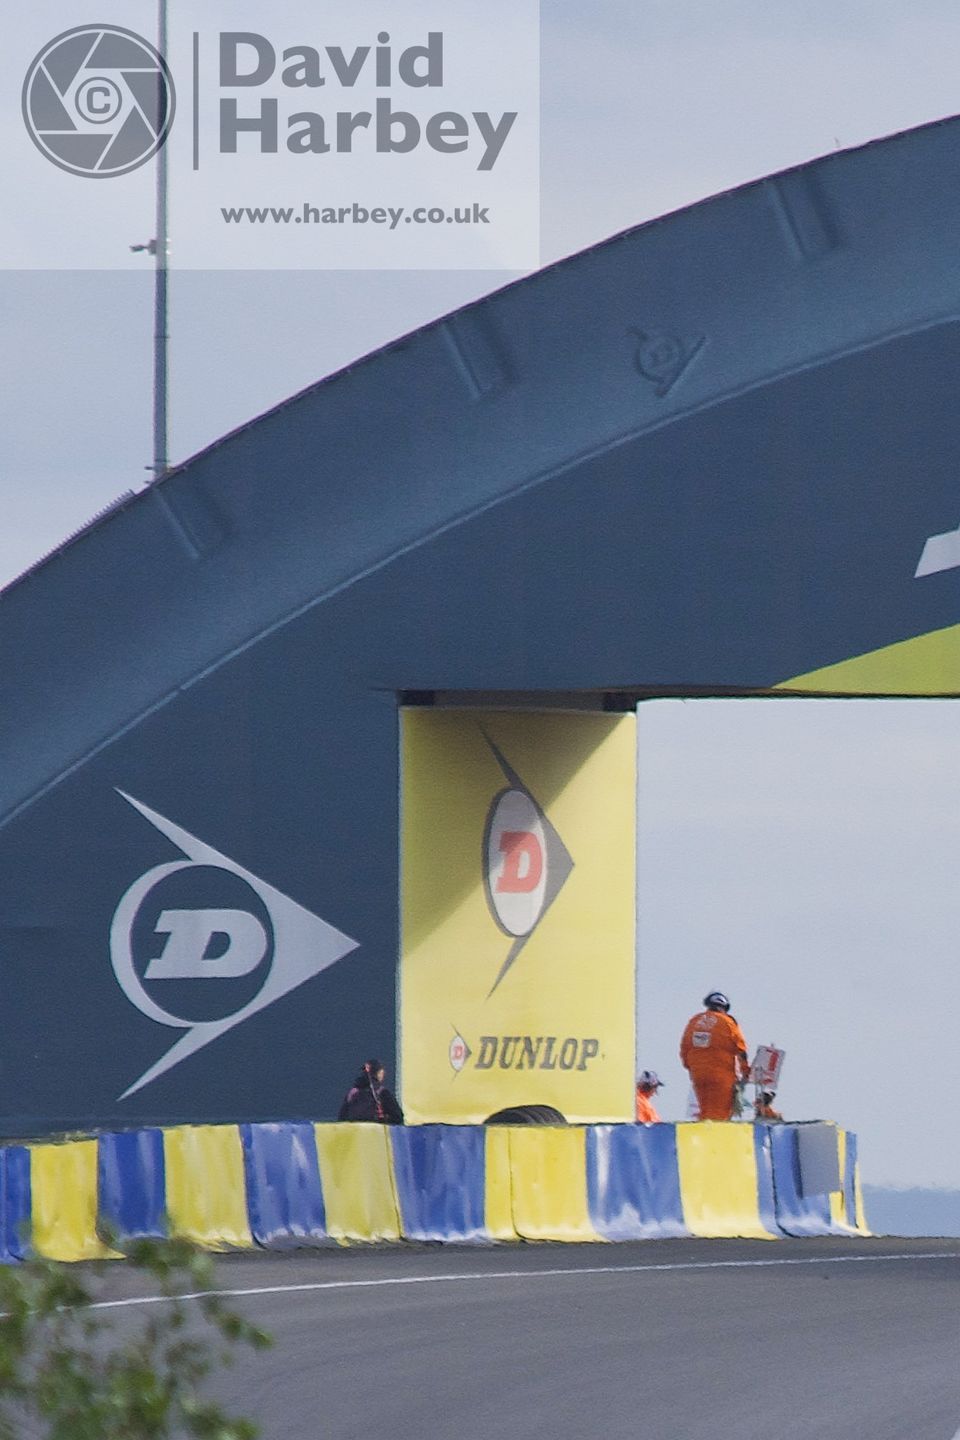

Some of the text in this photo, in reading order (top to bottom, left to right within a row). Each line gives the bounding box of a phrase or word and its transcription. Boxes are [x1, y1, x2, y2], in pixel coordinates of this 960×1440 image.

[496, 831, 543, 893] D
[145, 909, 268, 979] D
[474, 1036, 600, 1071] DUNLOP
